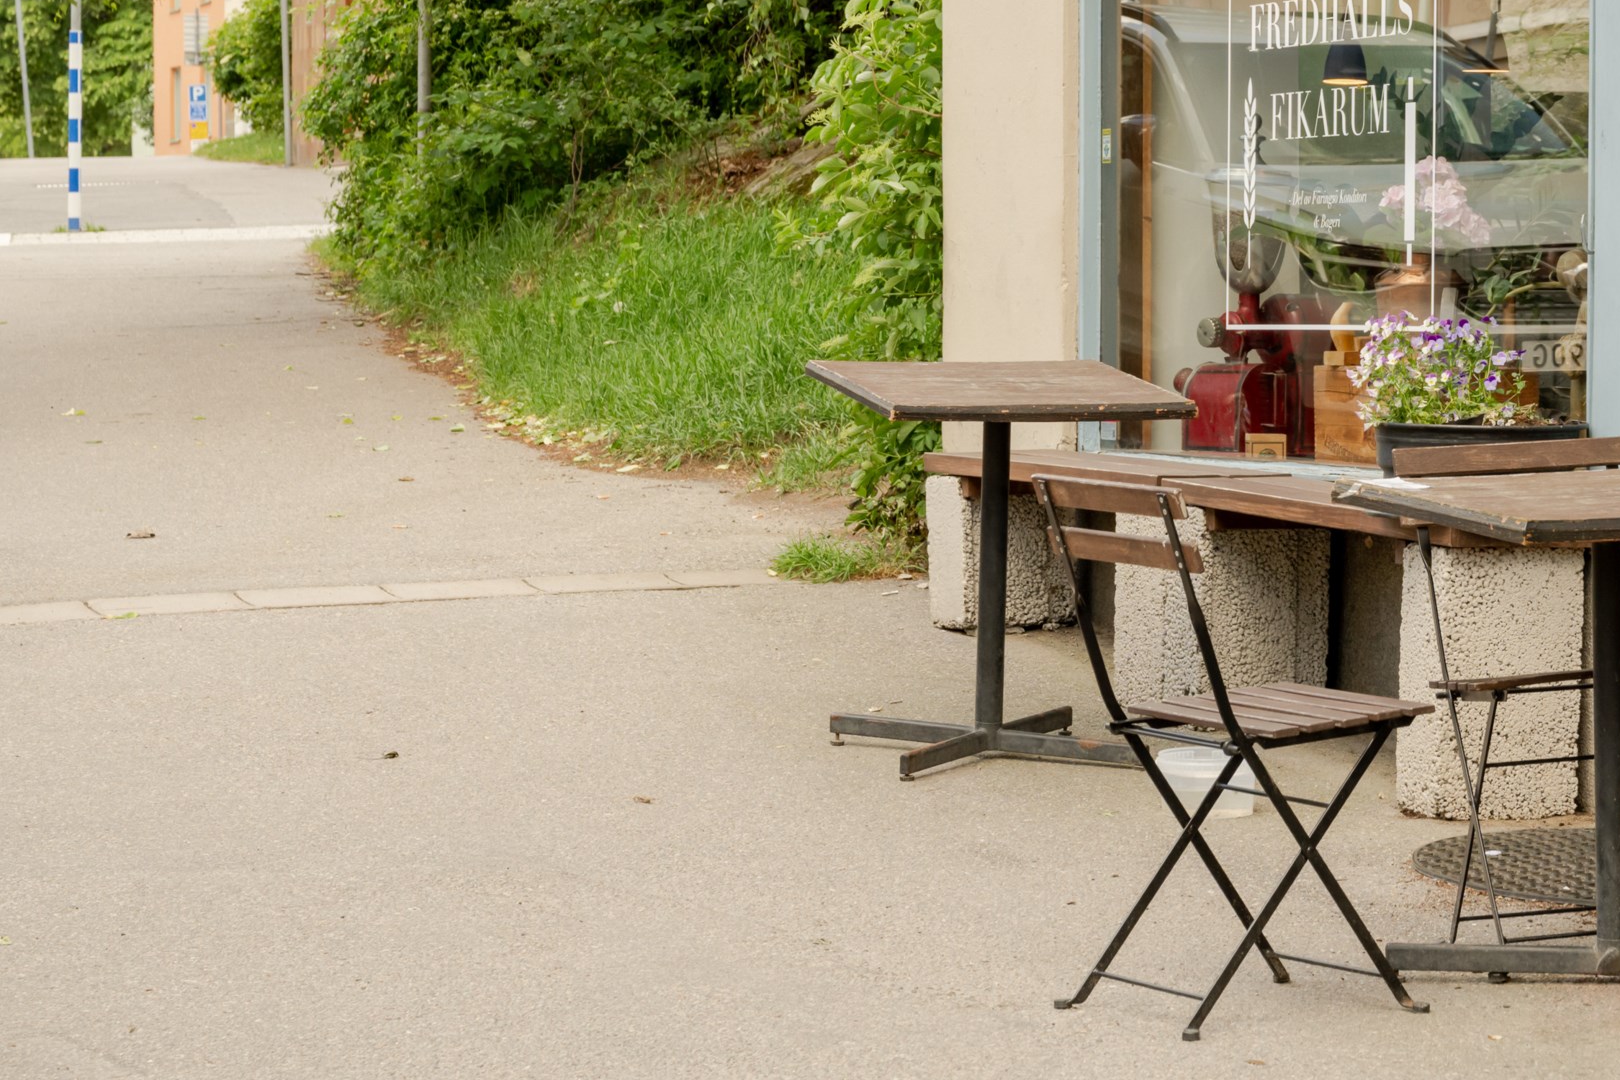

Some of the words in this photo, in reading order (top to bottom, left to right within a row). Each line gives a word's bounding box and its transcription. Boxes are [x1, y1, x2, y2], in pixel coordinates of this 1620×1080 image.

[192, 86, 204, 101] P
[1270, 83, 1391, 141] FIKARUM
[1292, 190, 1304, 206] Del
[1320, 214, 1341, 233] Bageri
